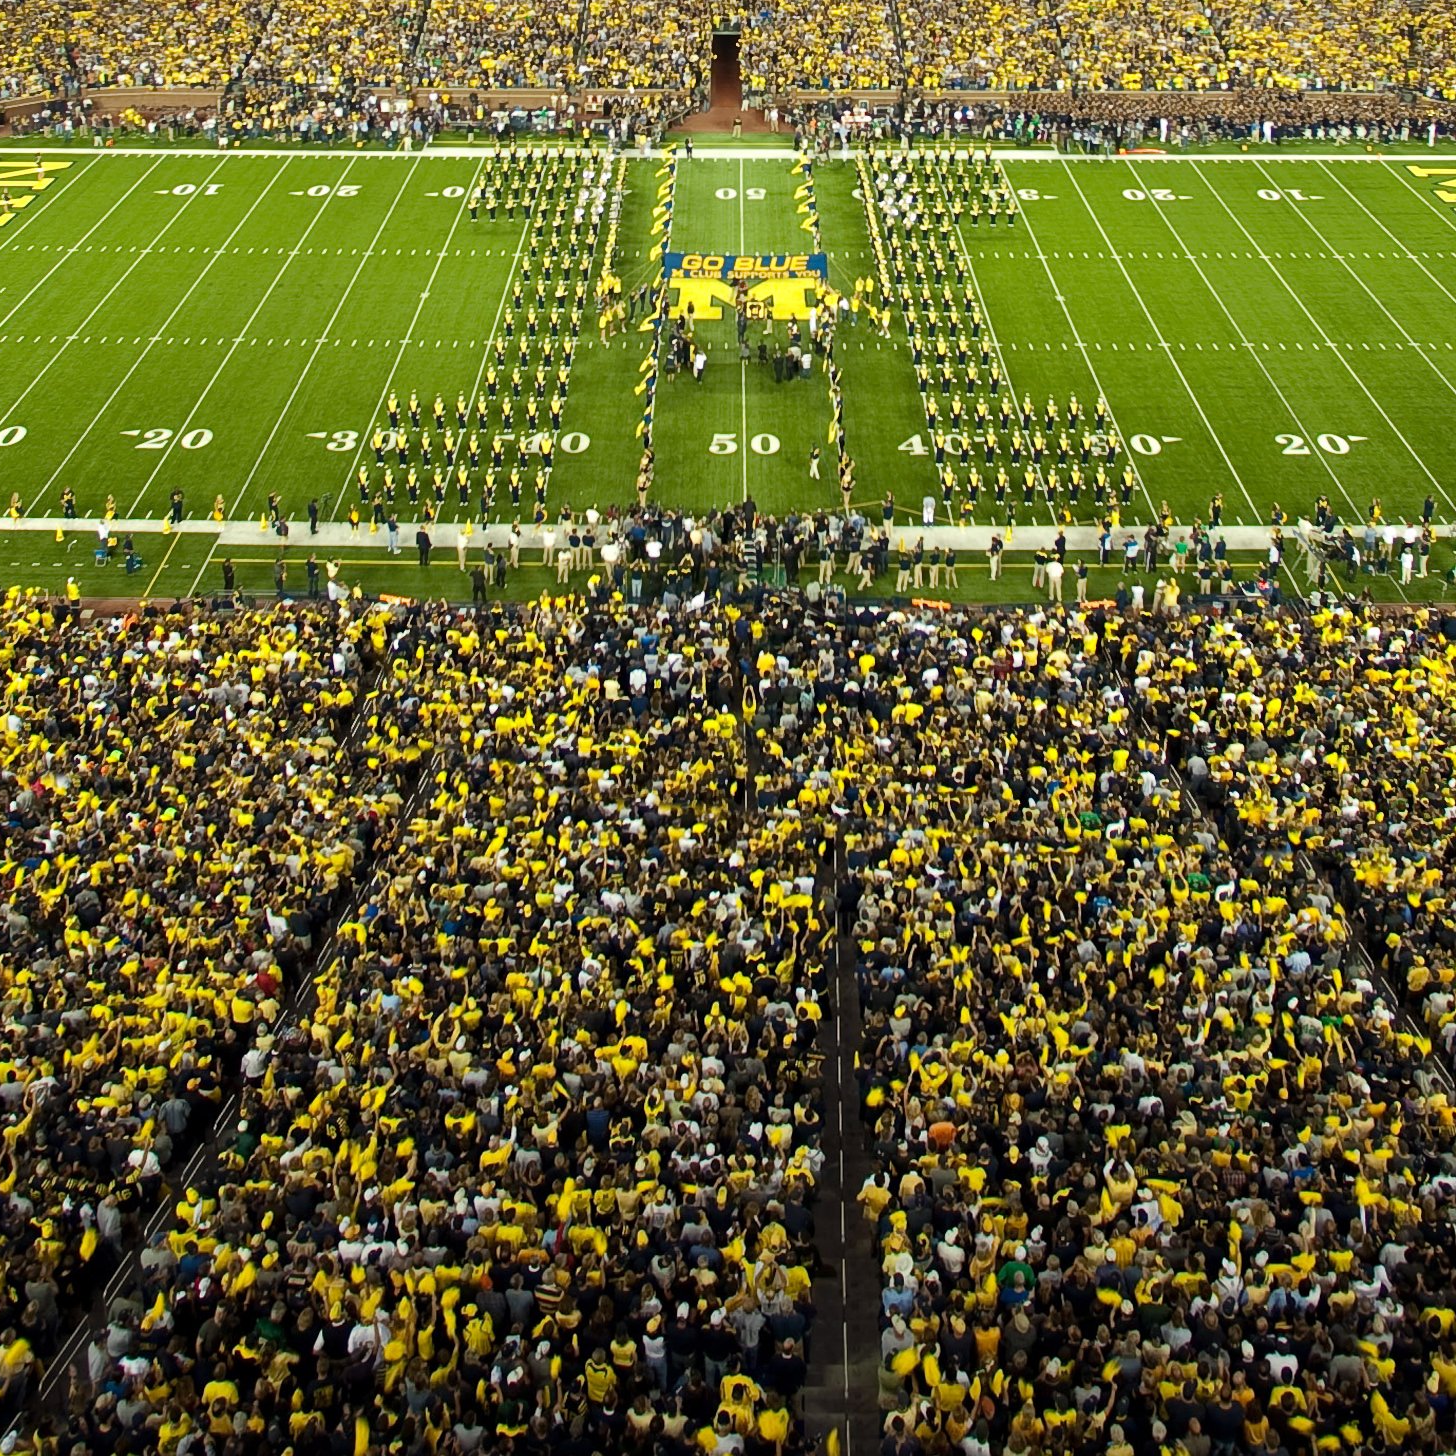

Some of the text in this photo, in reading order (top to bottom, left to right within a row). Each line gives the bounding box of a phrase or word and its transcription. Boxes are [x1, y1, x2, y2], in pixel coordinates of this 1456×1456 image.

[715, 187, 767, 200] 50
[681, 255, 809, 271] GO BLUE
[690, 269, 722, 279] CLUB
[727, 270, 790, 280] SUPPORTS
[796, 269, 821, 278] YOU
[134, 428, 214, 450] 20
[708, 433, 781, 455] 50
[1274, 433, 1351, 455] 20
